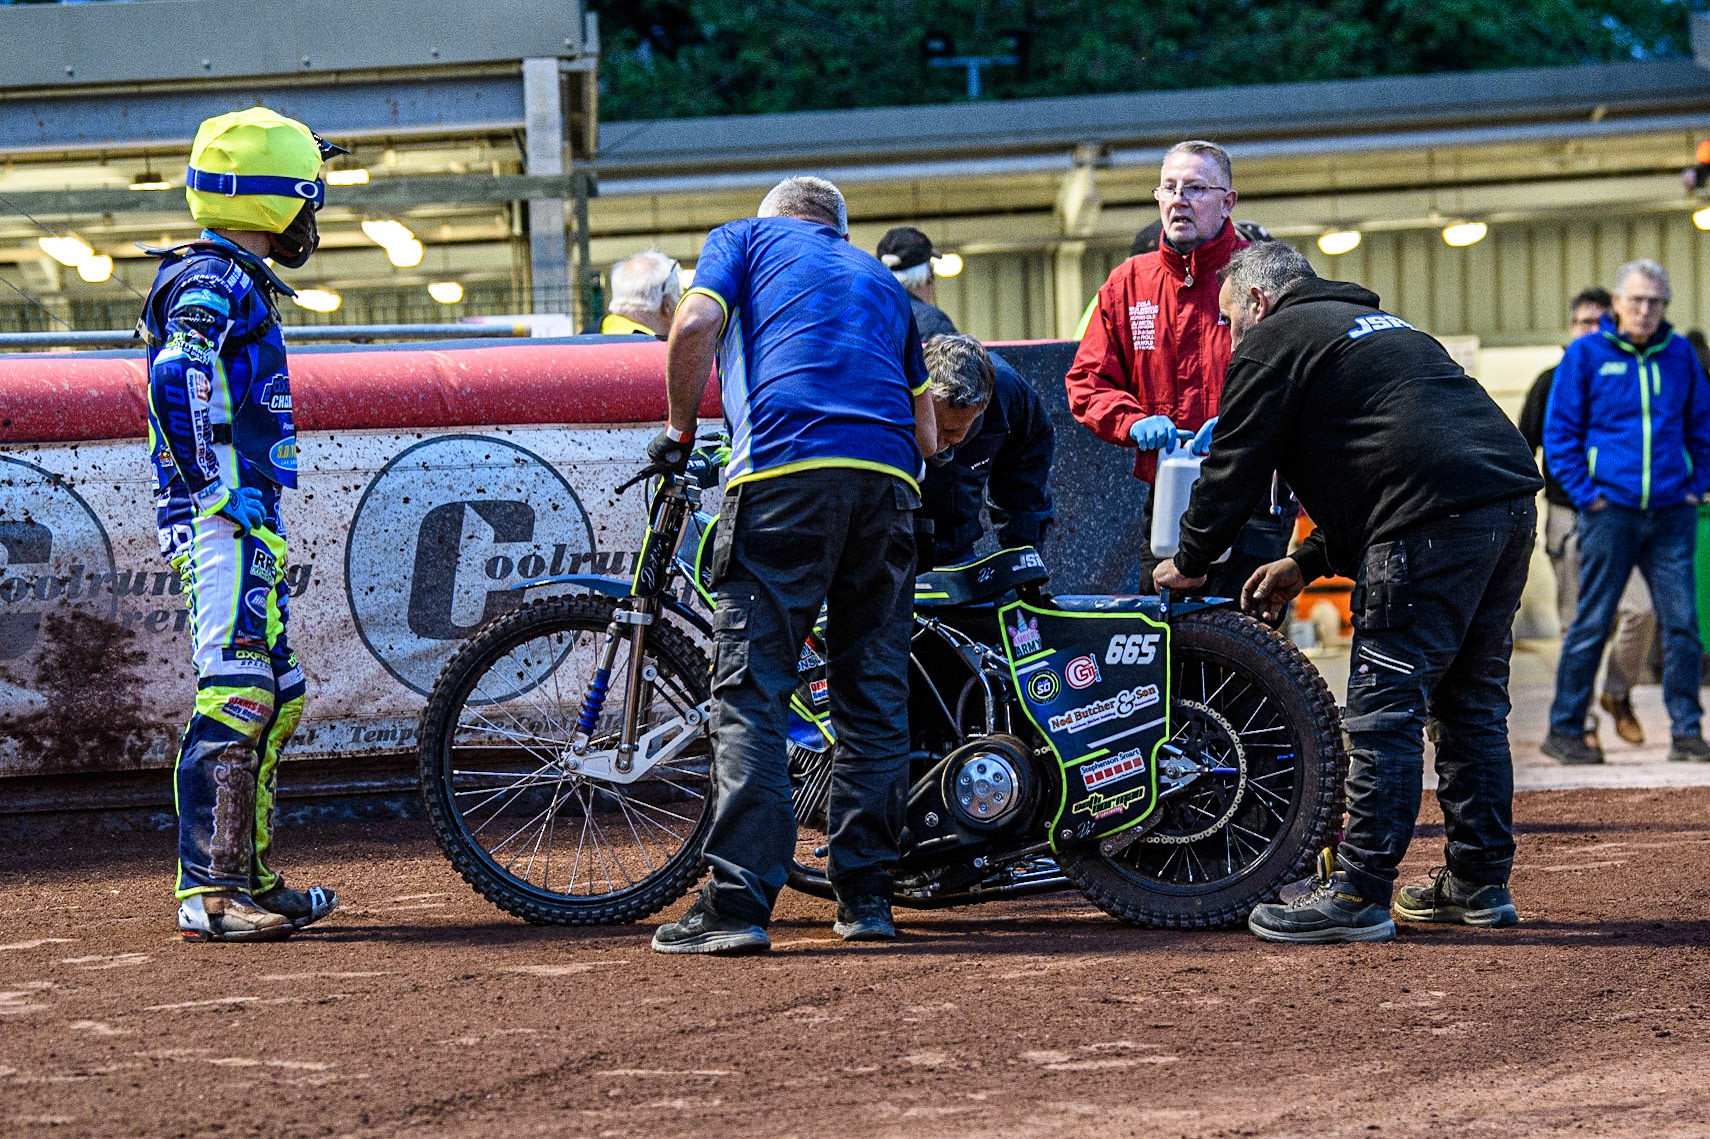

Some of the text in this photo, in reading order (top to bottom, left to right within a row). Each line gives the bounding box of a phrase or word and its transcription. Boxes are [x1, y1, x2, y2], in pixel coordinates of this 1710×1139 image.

[1016, 638, 1042, 657] ARMY
[1105, 634, 1160, 665] 665
[1074, 700, 1115, 720] Butcher
[1117, 693, 1136, 714] &
[1136, 686, 1156, 699] Son
[1119, 749, 1139, 760] Smart
